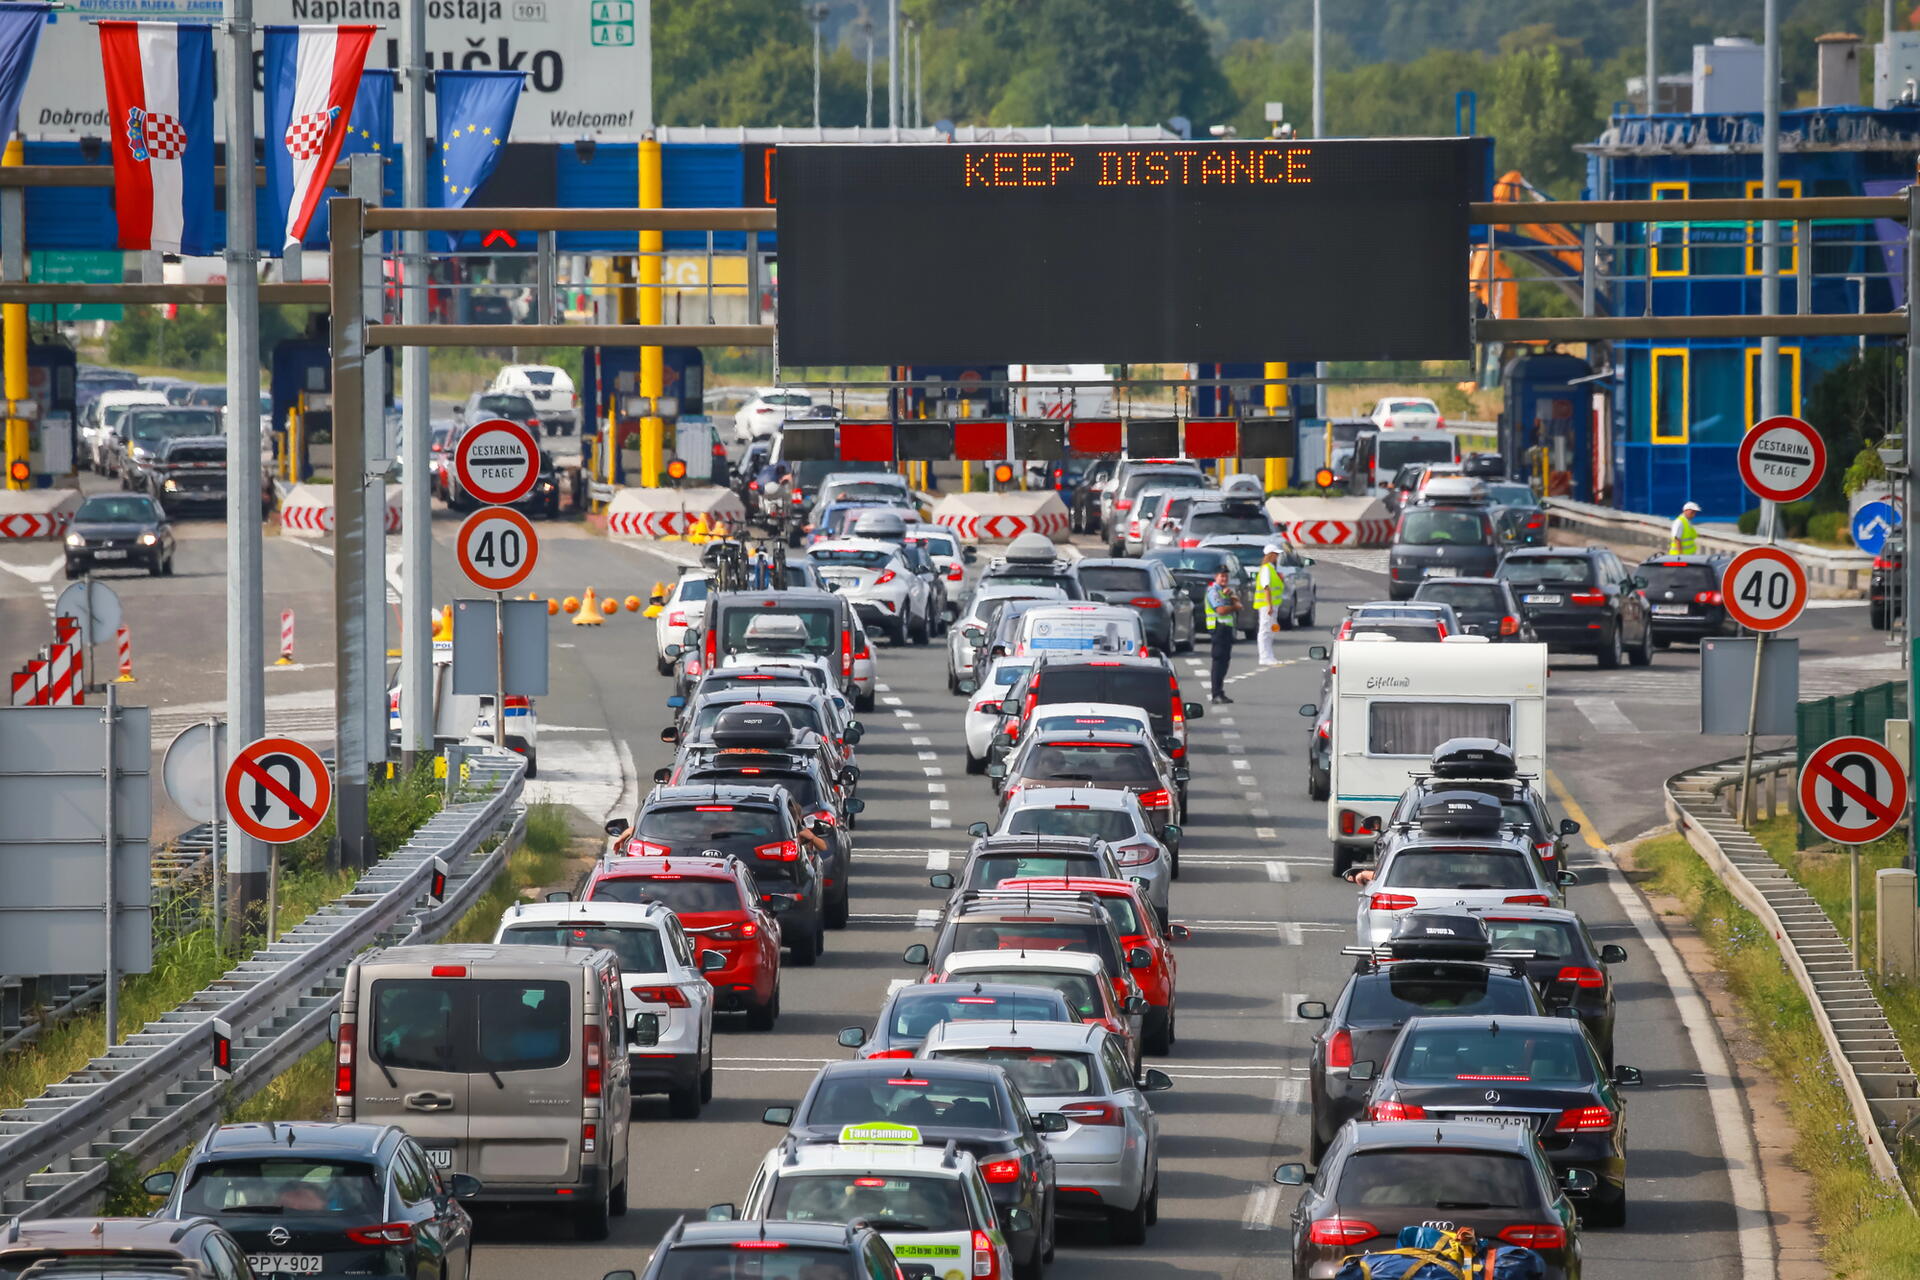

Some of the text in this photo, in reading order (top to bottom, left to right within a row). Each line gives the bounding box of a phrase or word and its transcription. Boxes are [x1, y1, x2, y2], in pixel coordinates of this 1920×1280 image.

[292, 0, 400, 22] Naplatna
[426, 0, 501, 24] ostaja
[550, 110, 634, 127] Welcome!
[965, 149, 1312, 187] KEEP DISTANCE
[472, 445, 522, 456] CESTARINA
[1758, 439, 1809, 456] CESTARINA
[482, 467, 514, 479] PEAGE
[1763, 463, 1797, 478] PEAGE
[475, 529, 520, 568] 40
[1740, 570, 1788, 610] 40
